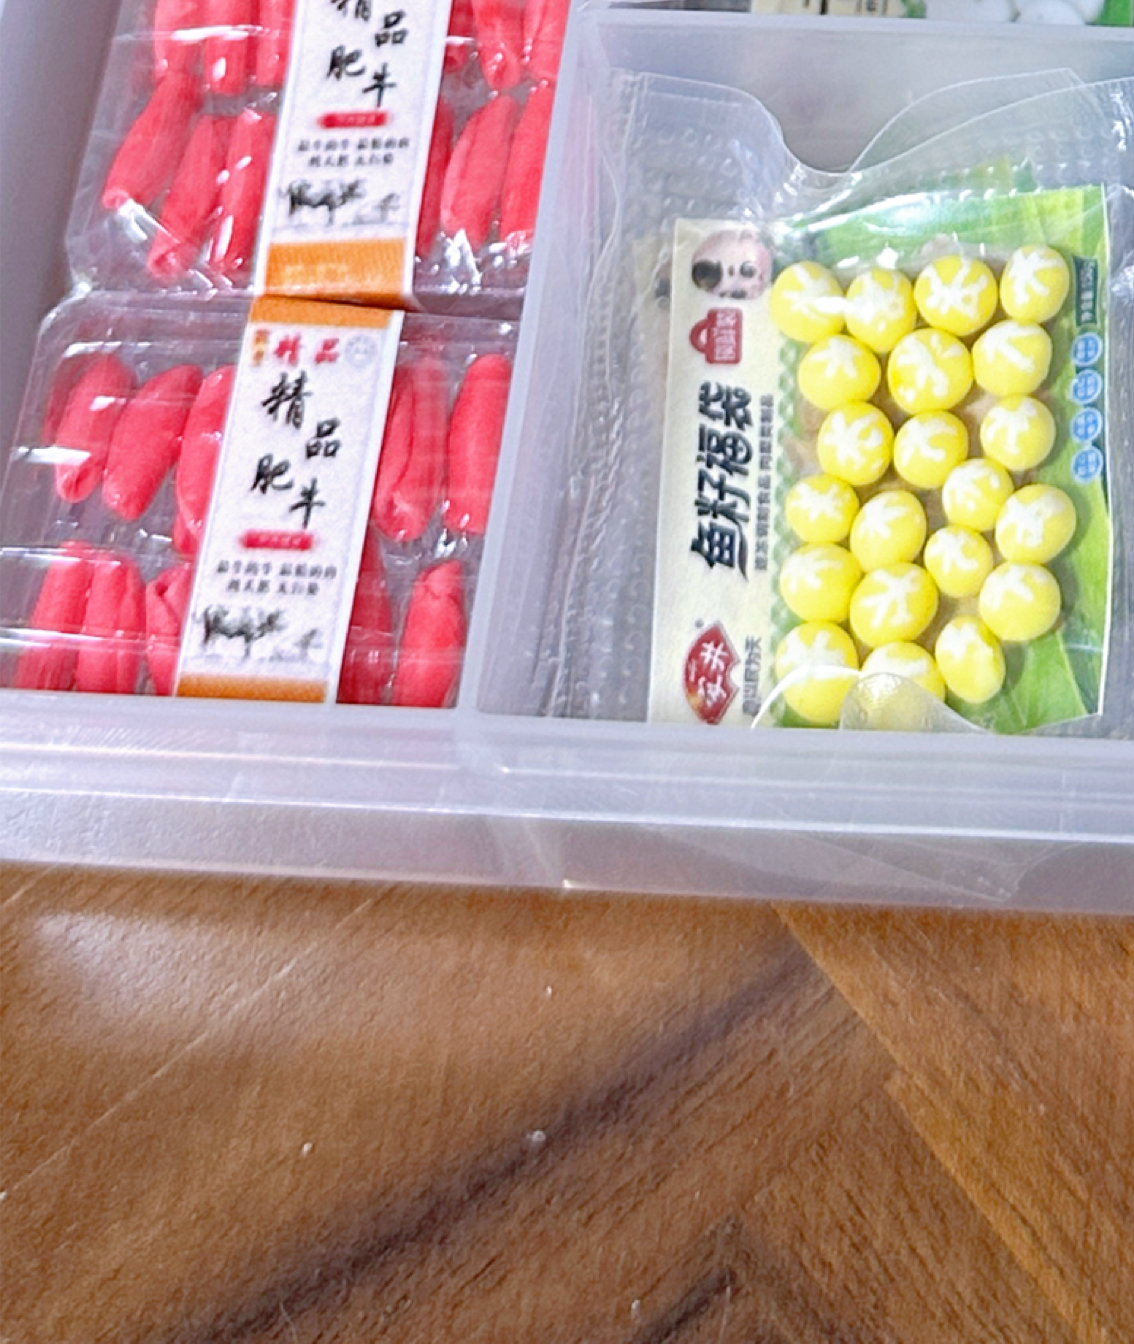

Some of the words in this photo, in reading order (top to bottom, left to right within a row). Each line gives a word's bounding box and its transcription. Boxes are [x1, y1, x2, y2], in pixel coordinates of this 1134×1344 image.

[250, 369, 342, 530] 精品肥牛
[690, 379, 755, 582] 鱼籽福袋
[696, 639, 728, 707] 安井
